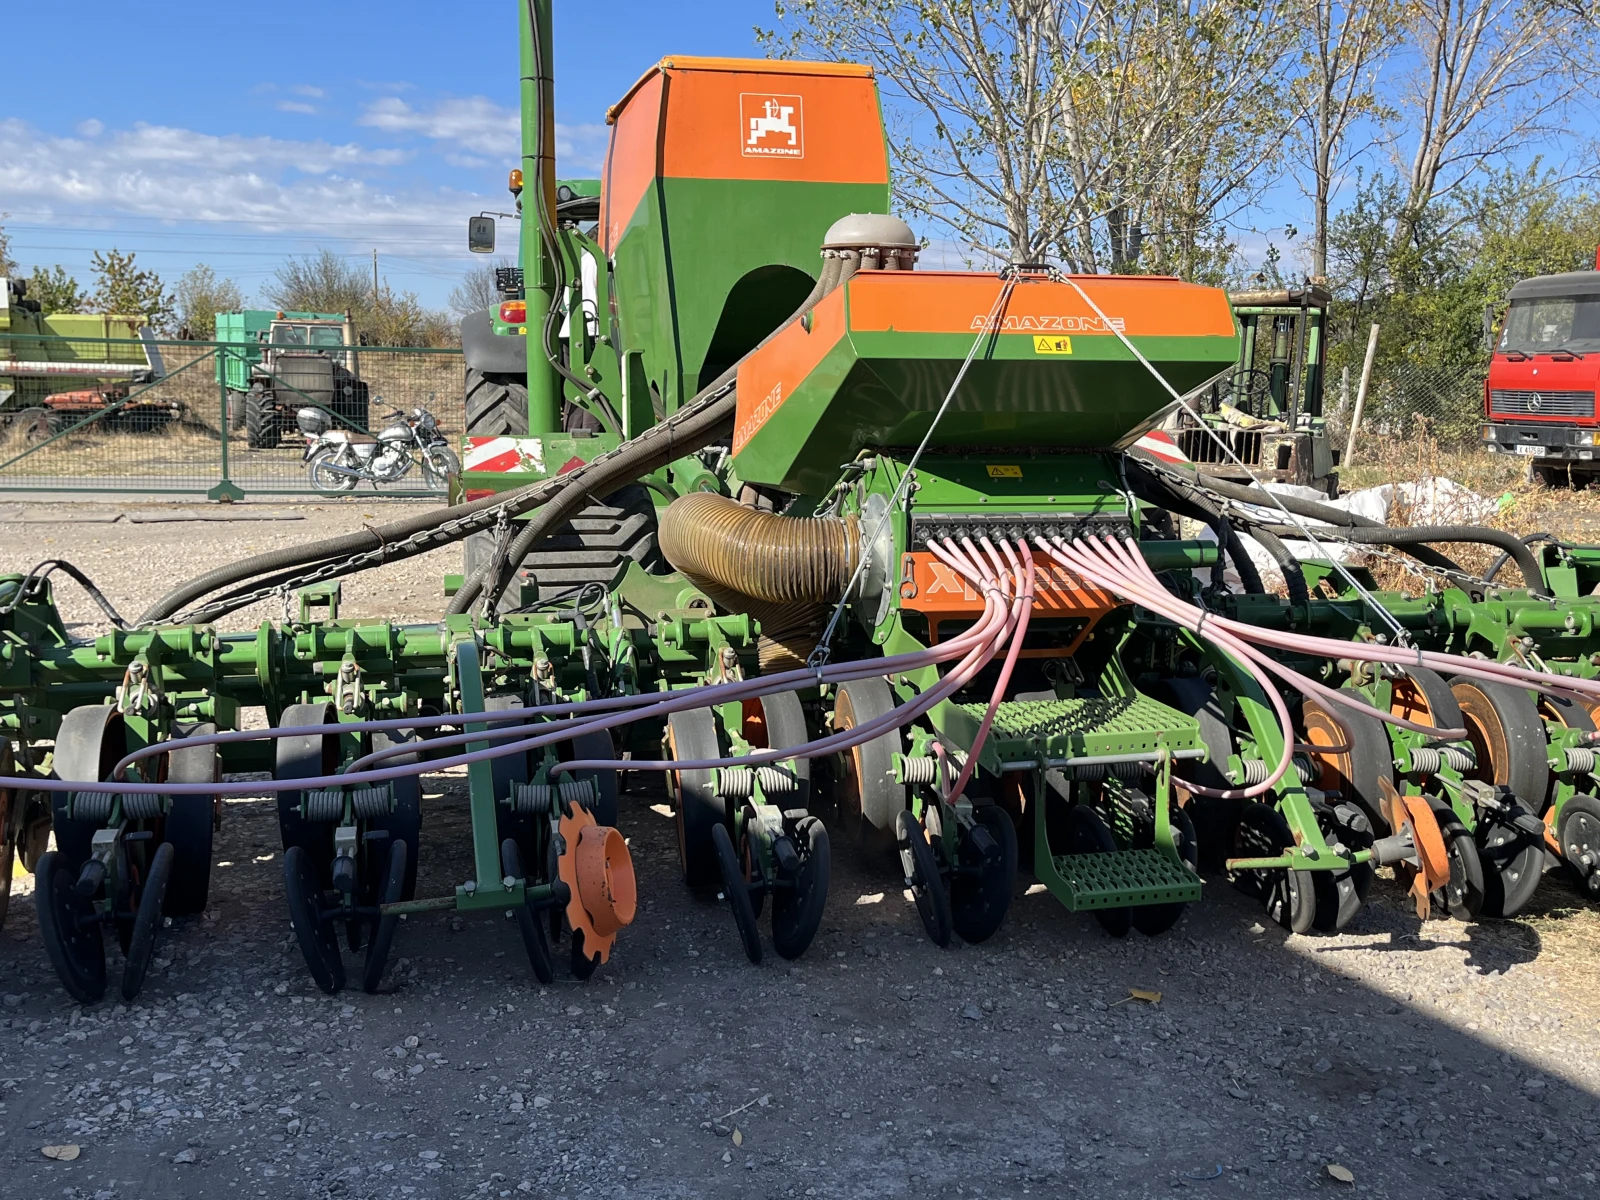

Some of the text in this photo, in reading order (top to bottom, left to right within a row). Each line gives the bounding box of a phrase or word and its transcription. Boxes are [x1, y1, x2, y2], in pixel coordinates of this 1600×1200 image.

[744, 147, 801, 155] AMAZONE
[970, 315, 1126, 331] AMAZONE
[735, 382, 782, 450] AMAZONE
